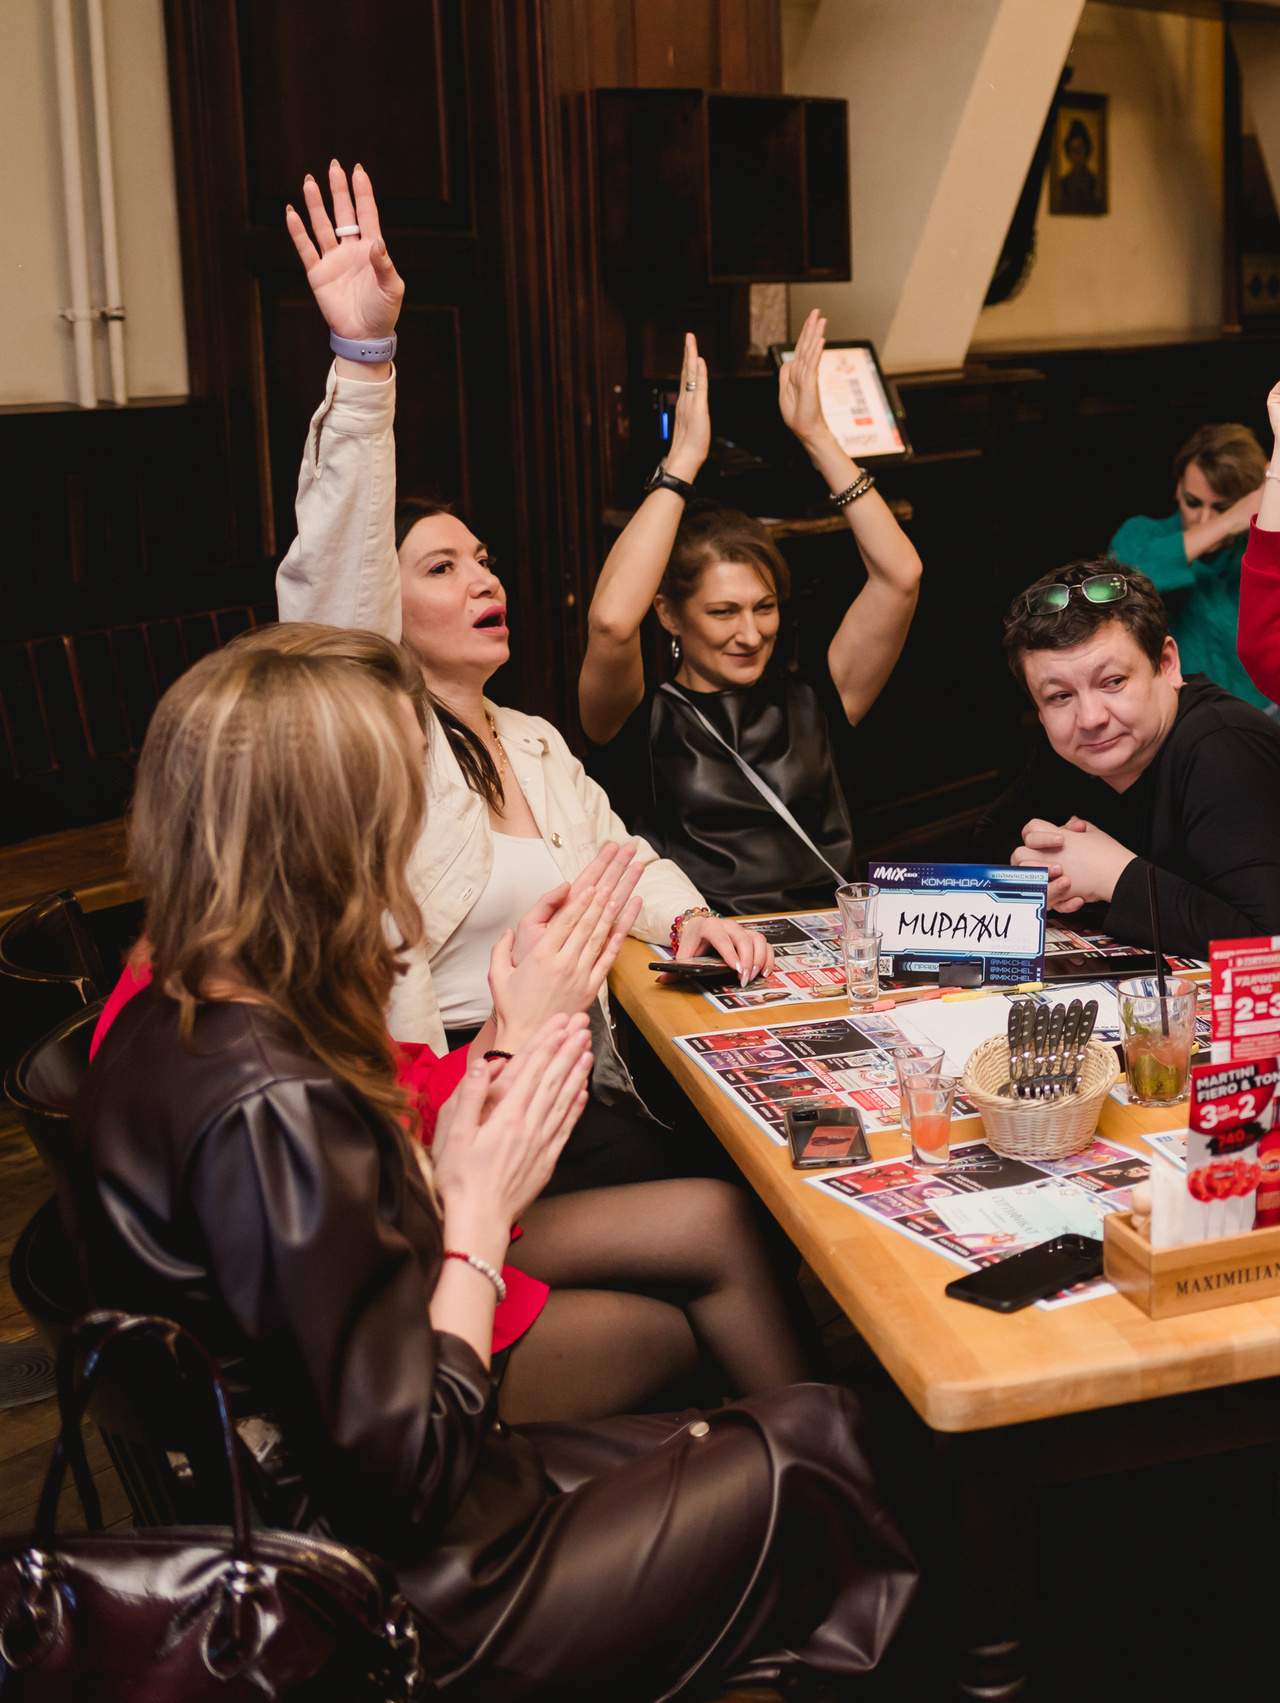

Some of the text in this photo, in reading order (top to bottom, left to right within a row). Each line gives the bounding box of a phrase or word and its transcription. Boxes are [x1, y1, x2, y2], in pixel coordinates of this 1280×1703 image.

[898, 911, 1012, 942] МИРАЖИ
[1251, 984, 1273, 995] ЧАС
[1196, 1065, 1255, 1091] MARTINI
[1196, 1083, 1238, 1103] FIERO
[1241, 1079, 1251, 1091] &
[1200, 1104, 1218, 1129] 3
[1238, 1094, 1256, 1120] 2
